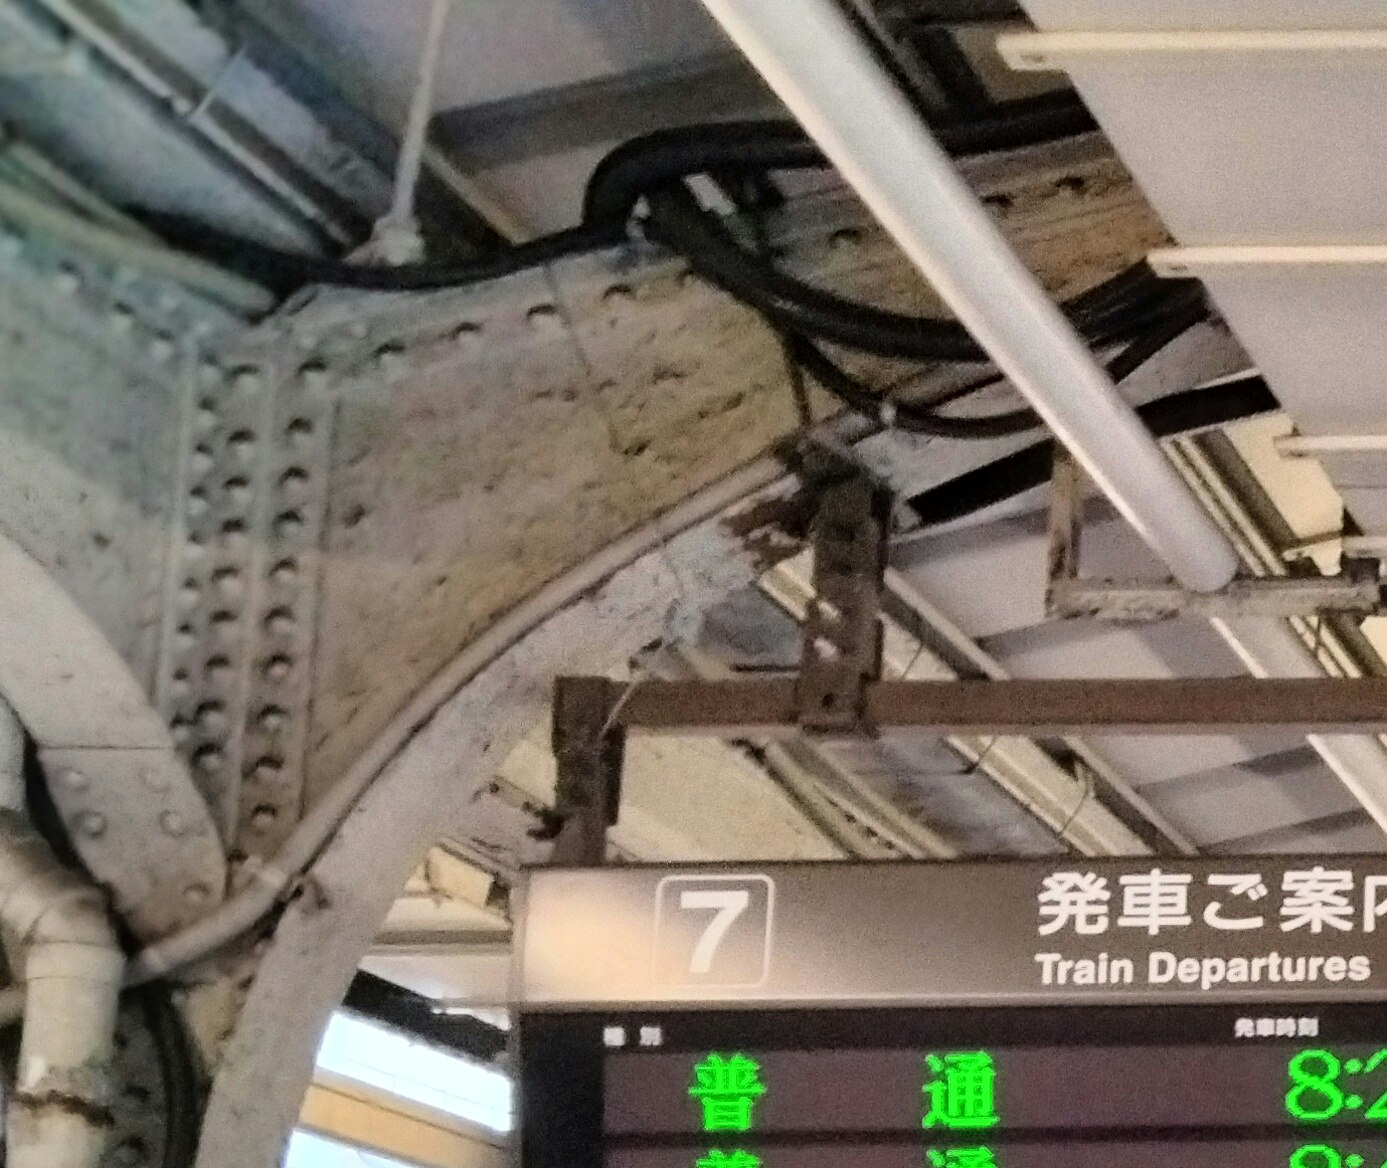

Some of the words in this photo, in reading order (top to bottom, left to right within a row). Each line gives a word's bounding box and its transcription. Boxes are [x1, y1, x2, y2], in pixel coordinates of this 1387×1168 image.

[679, 890, 750, 974] 7
[1034, 952, 1136, 987] Train
[1147, 952, 1372, 993] Departures
